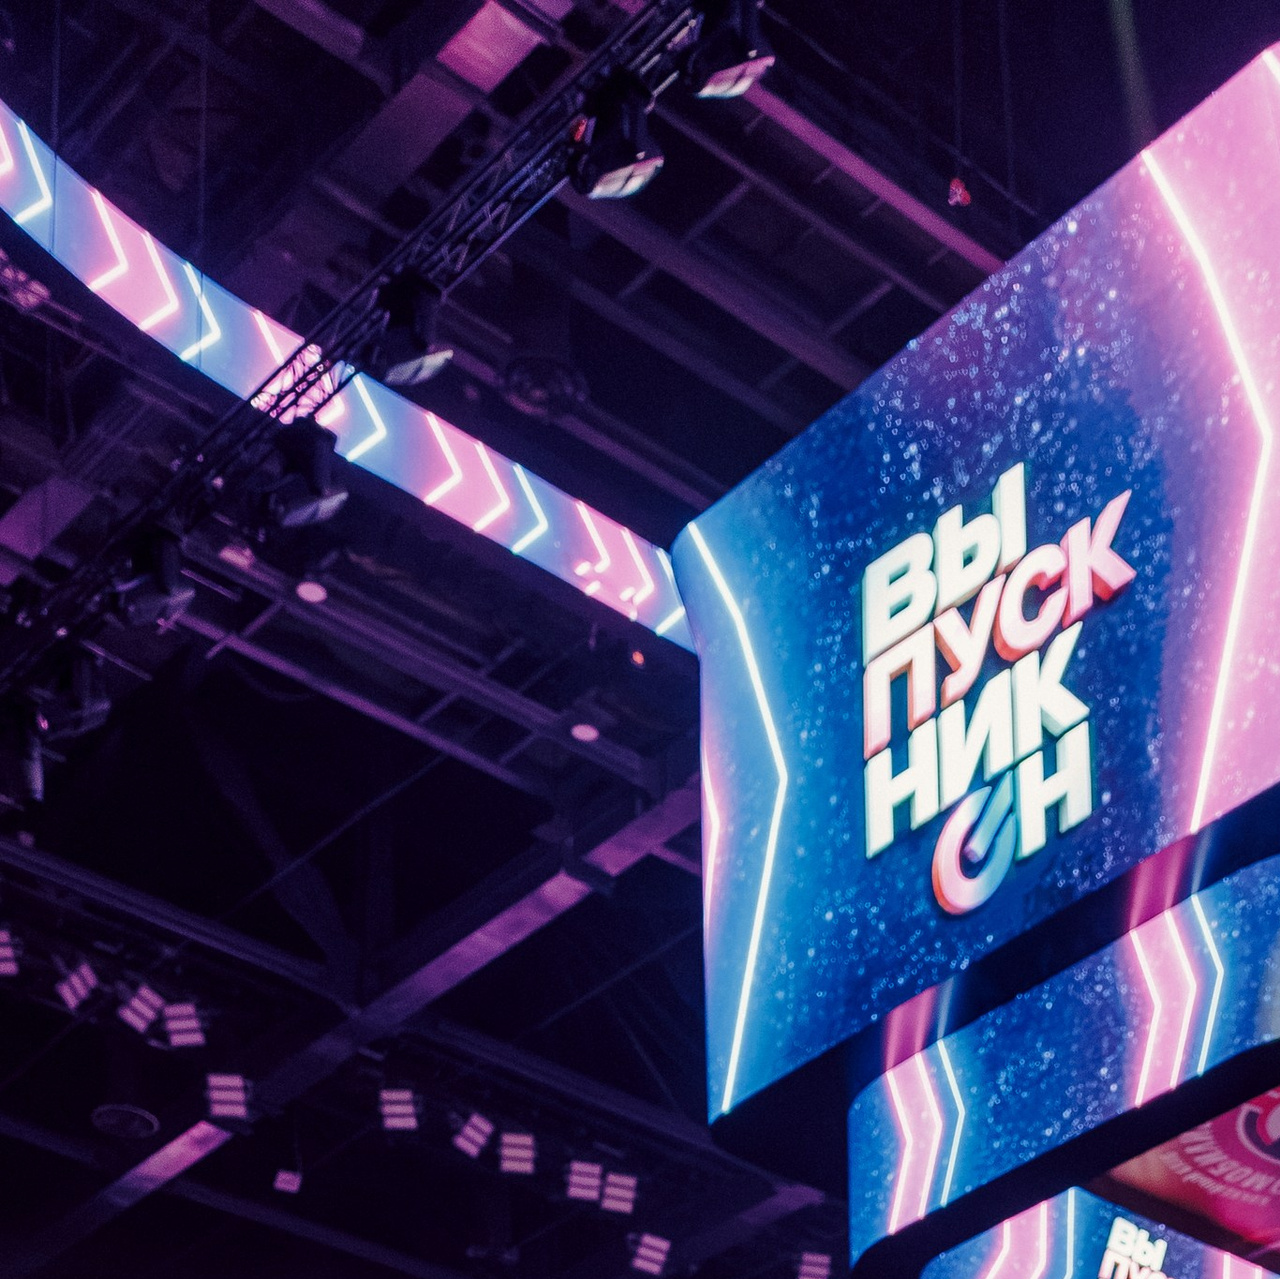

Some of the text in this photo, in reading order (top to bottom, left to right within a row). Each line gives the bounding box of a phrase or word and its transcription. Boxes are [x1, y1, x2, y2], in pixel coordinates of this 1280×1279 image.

[863, 461, 1028, 668] ВЫ
[863, 489, 1137, 761] ПУСК
[864, 620, 1090, 860] НИК
[1107, 1216, 1168, 1272] ВЫ
